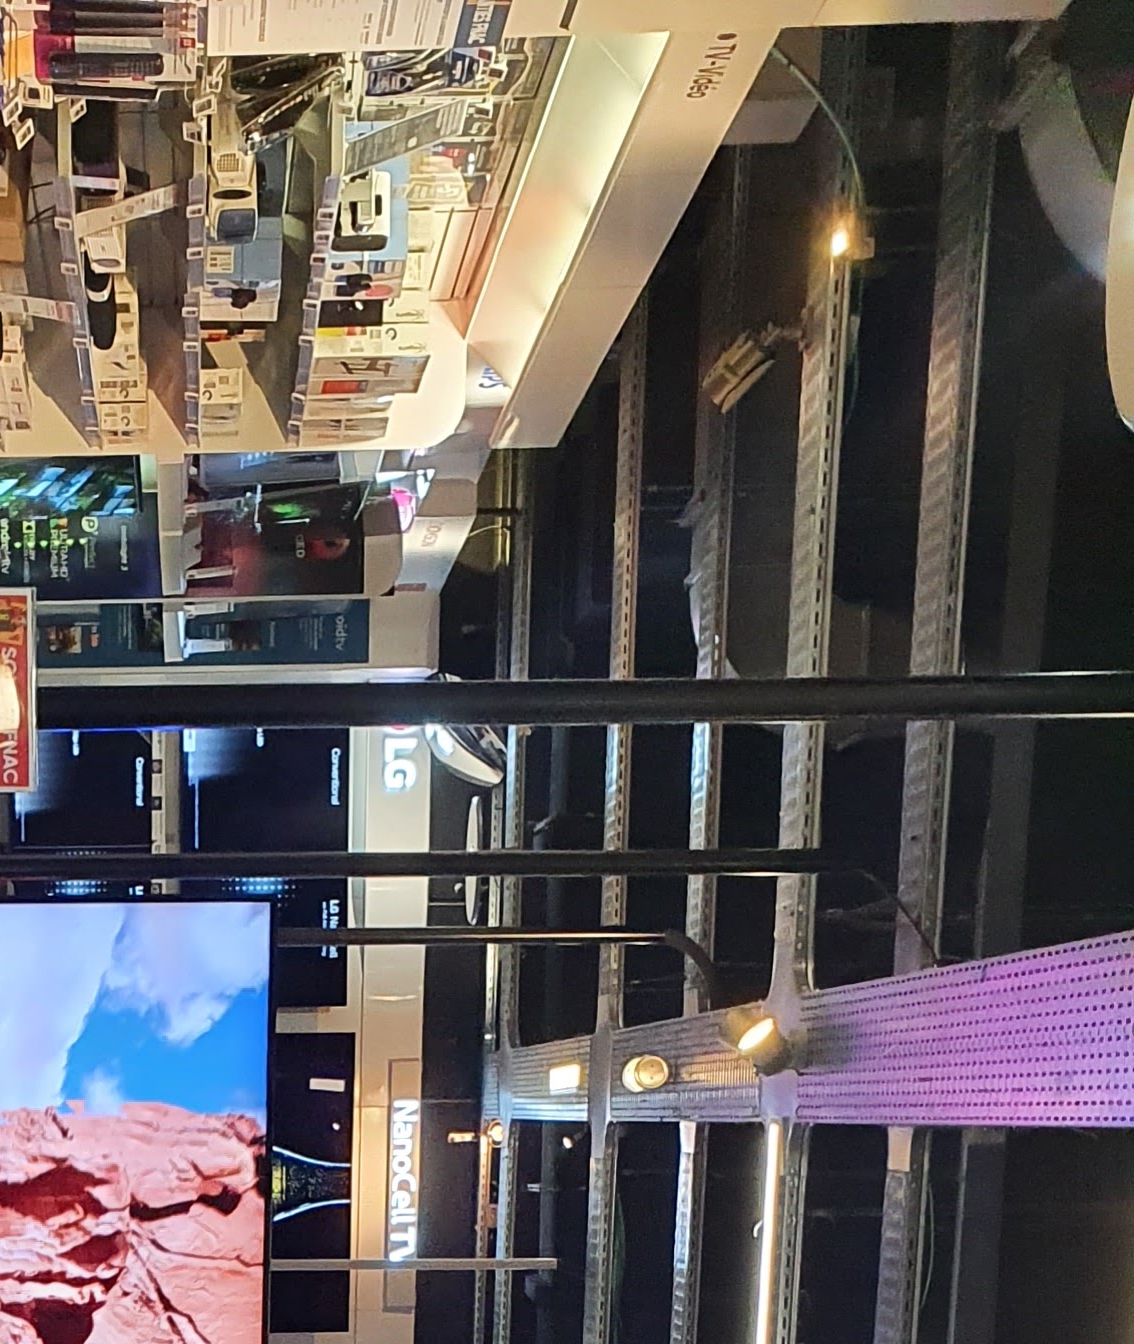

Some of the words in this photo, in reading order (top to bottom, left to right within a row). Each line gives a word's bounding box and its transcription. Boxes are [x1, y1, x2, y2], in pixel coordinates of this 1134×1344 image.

[685, 44, 737, 98] TV-Vidéo
[1, 731, 18, 784] FNAC
[330, 747, 341, 806] Conventional
[384, 737, 418, 790] LG
[390, 1100, 420, 1224] NanoCell
